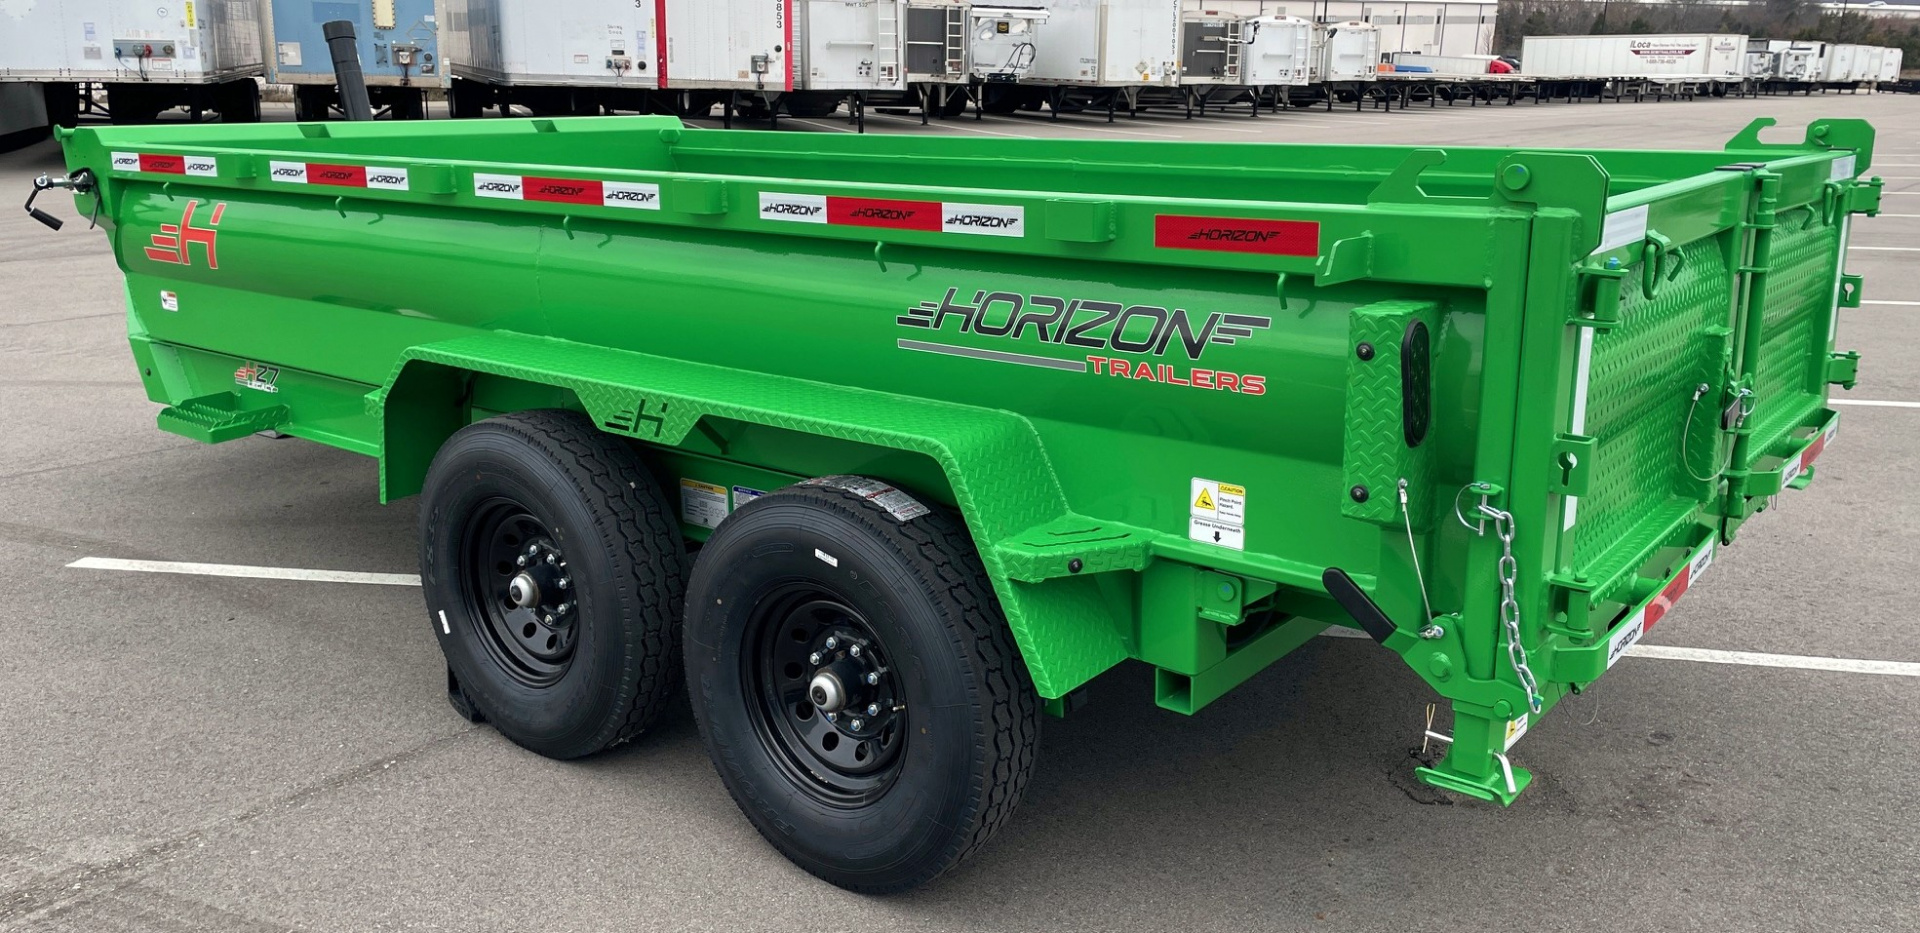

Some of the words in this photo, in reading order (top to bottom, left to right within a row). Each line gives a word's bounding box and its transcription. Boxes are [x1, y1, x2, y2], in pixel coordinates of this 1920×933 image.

[273, 168, 304, 177] HORIZON
[369, 174, 405, 184] HORIZON
[479, 182, 520, 193] HORIZON
[540, 185, 583, 196] HORIZON
[606, 190, 655, 202] HORIZON
[763, 203, 821, 216] HORIZON
[851, 207, 914, 220] HORIZON
[946, 214, 1017, 228] HORIZON
[1188, 228, 1280, 242] HORIZON
[920, 287, 1240, 360] HORIZON
[1087, 356, 1267, 396] TRAILERS
[1194, 519, 1211, 528] Grease
[1212, 523, 1241, 533] Underneath
